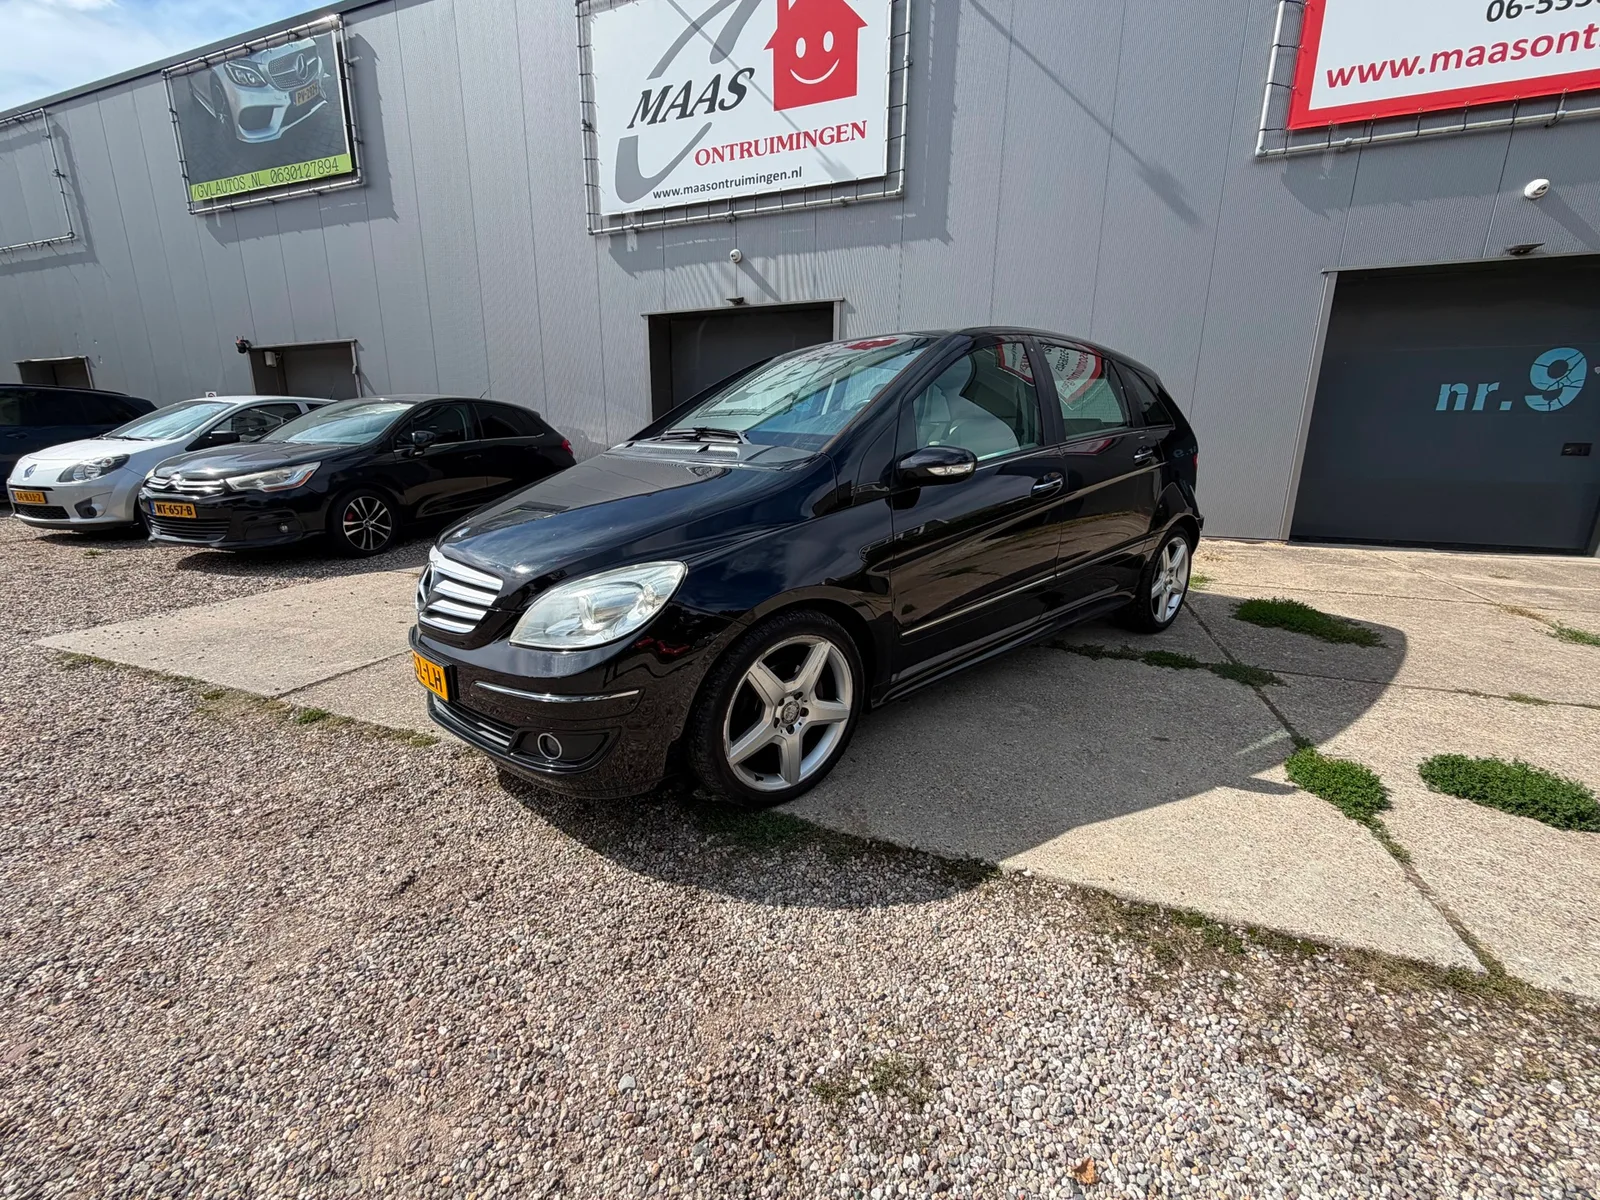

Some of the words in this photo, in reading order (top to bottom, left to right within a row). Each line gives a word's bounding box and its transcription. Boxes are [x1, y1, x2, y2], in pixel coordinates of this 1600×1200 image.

[1326, 22, 1600, 89] www.maasont
[626, 66, 756, 130] MAAS
[694, 119, 868, 167] ONTRUIMINGEN
[270, 157, 339, 184] 0630127894
[652, 165, 803, 200] www.maasontruimingen.nl
[156, 503, 193, 516] NT-657-B
